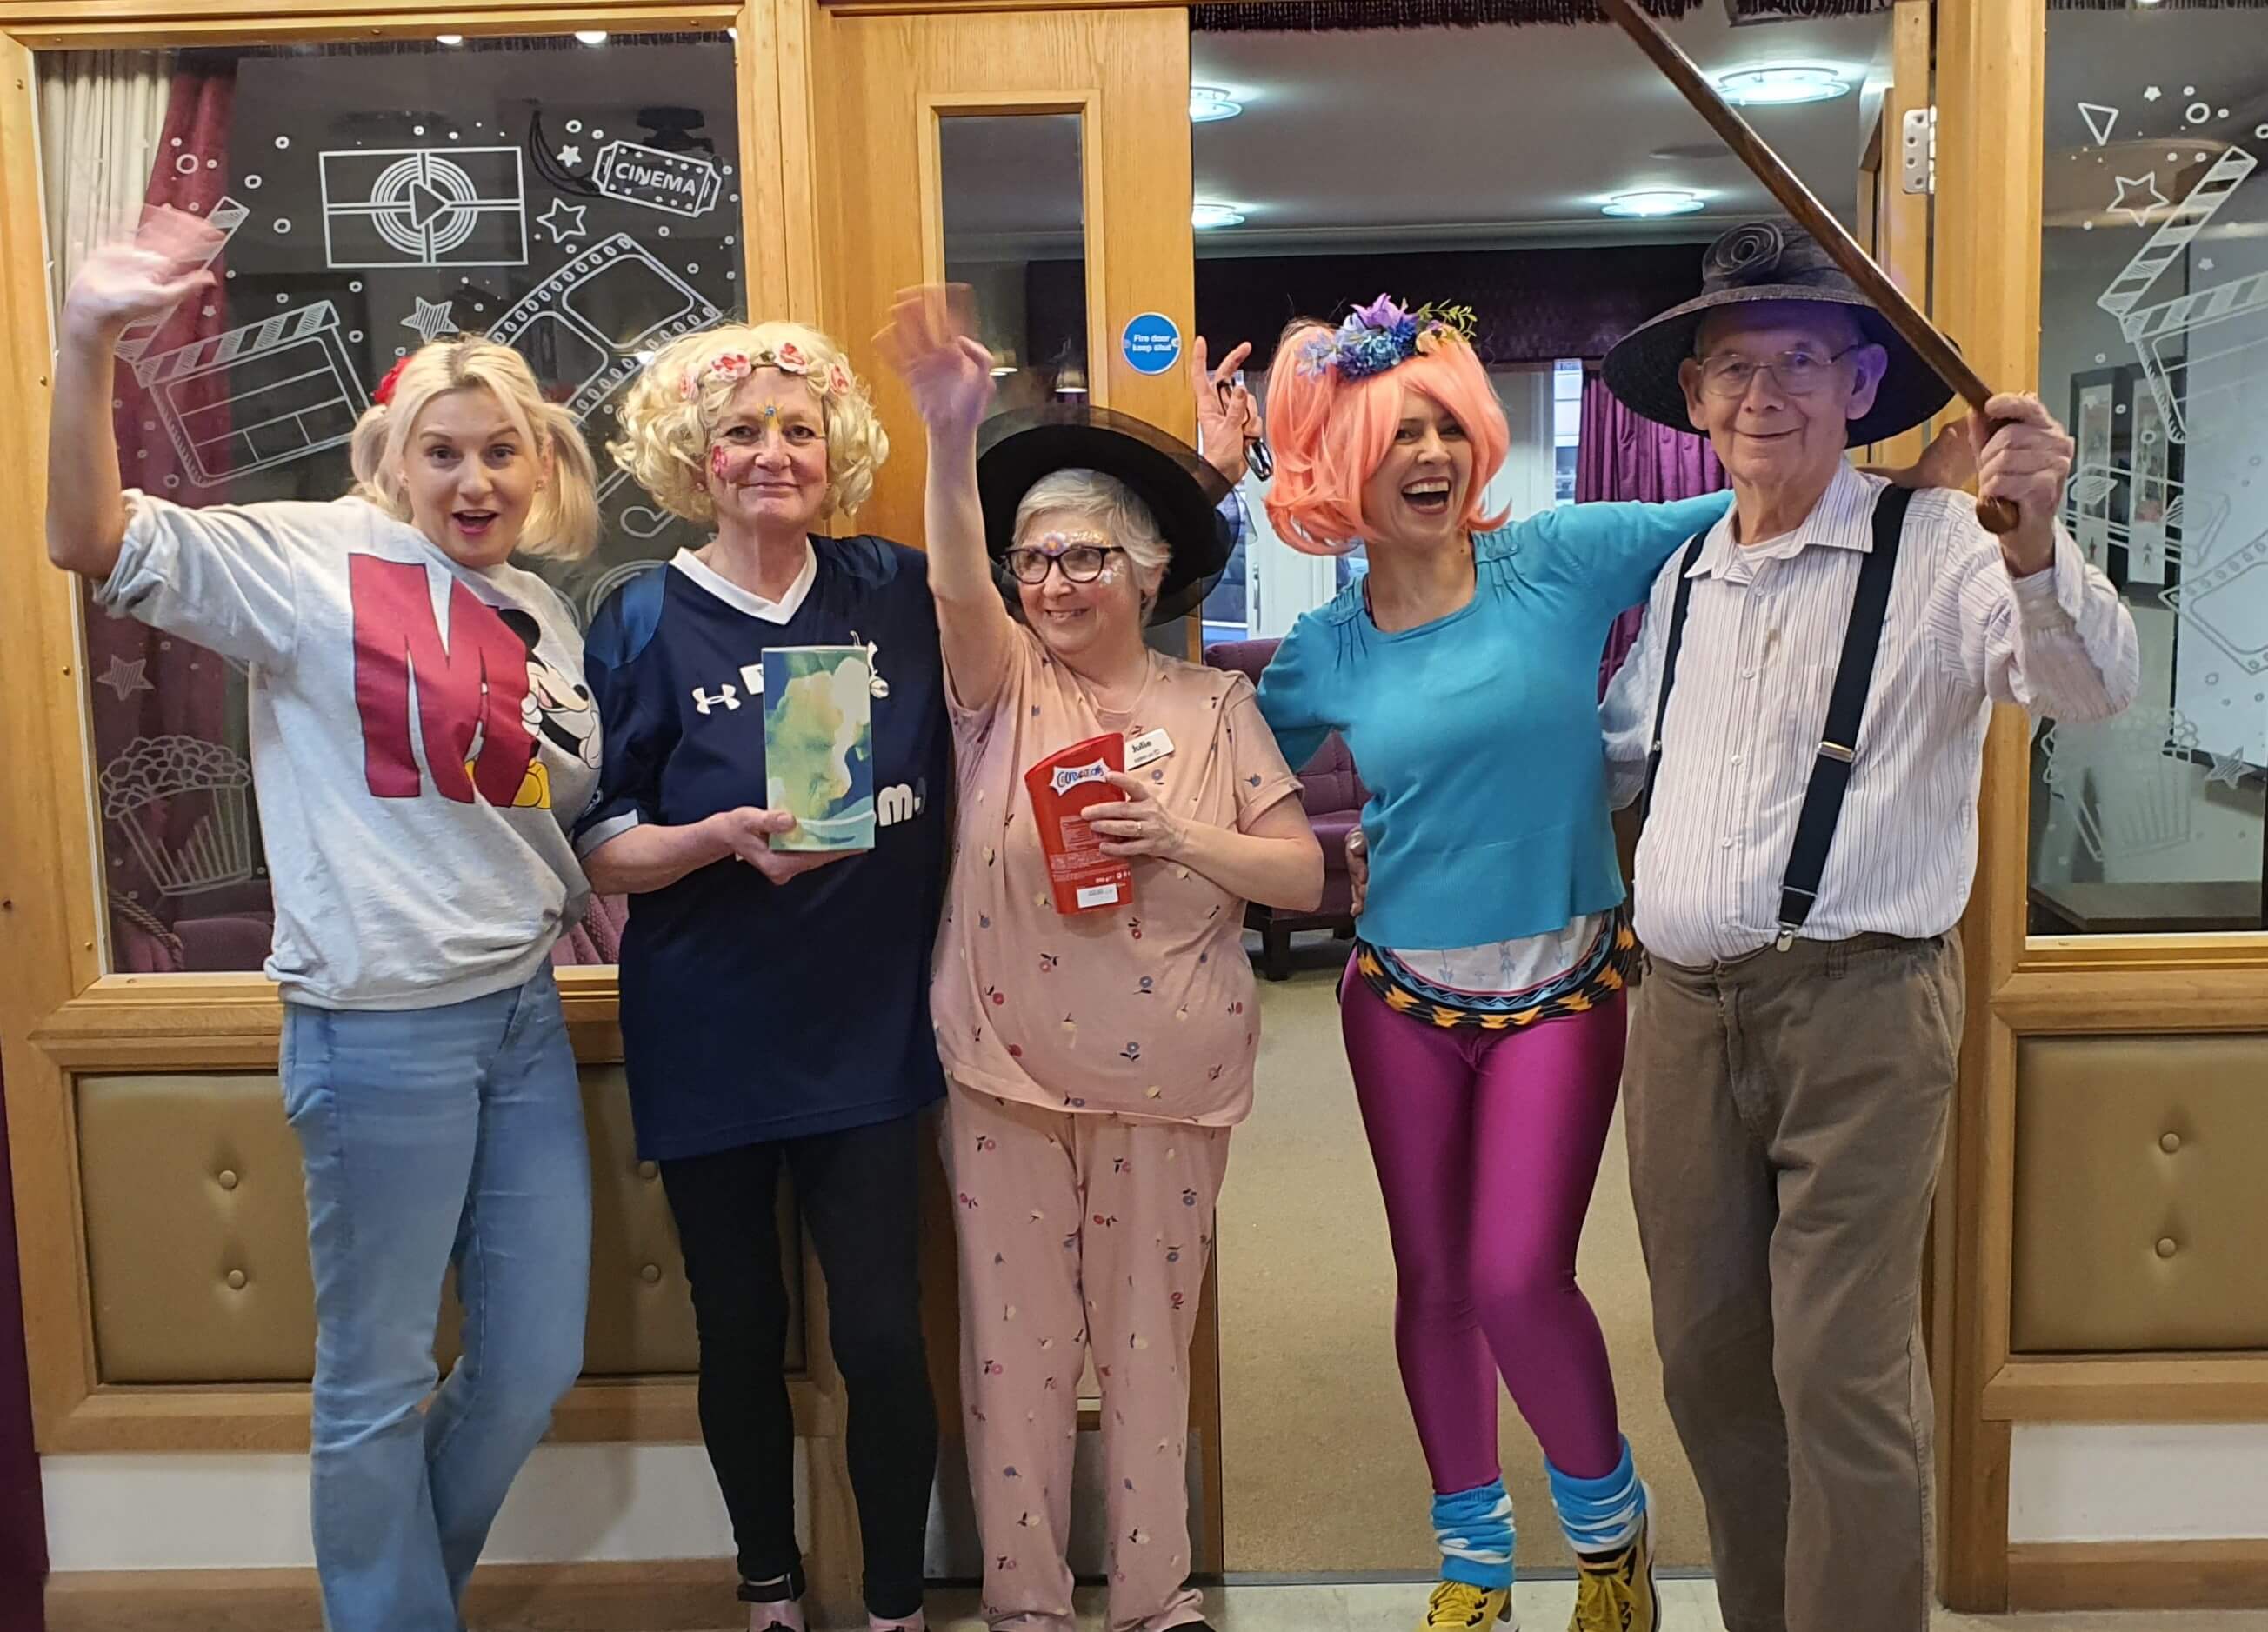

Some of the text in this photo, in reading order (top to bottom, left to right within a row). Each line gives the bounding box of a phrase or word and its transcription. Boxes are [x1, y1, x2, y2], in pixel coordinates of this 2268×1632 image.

[615, 163, 696, 197] CINEMA
[1133, 334, 1170, 343] Fire door
[1132, 343, 1152, 353] keep
